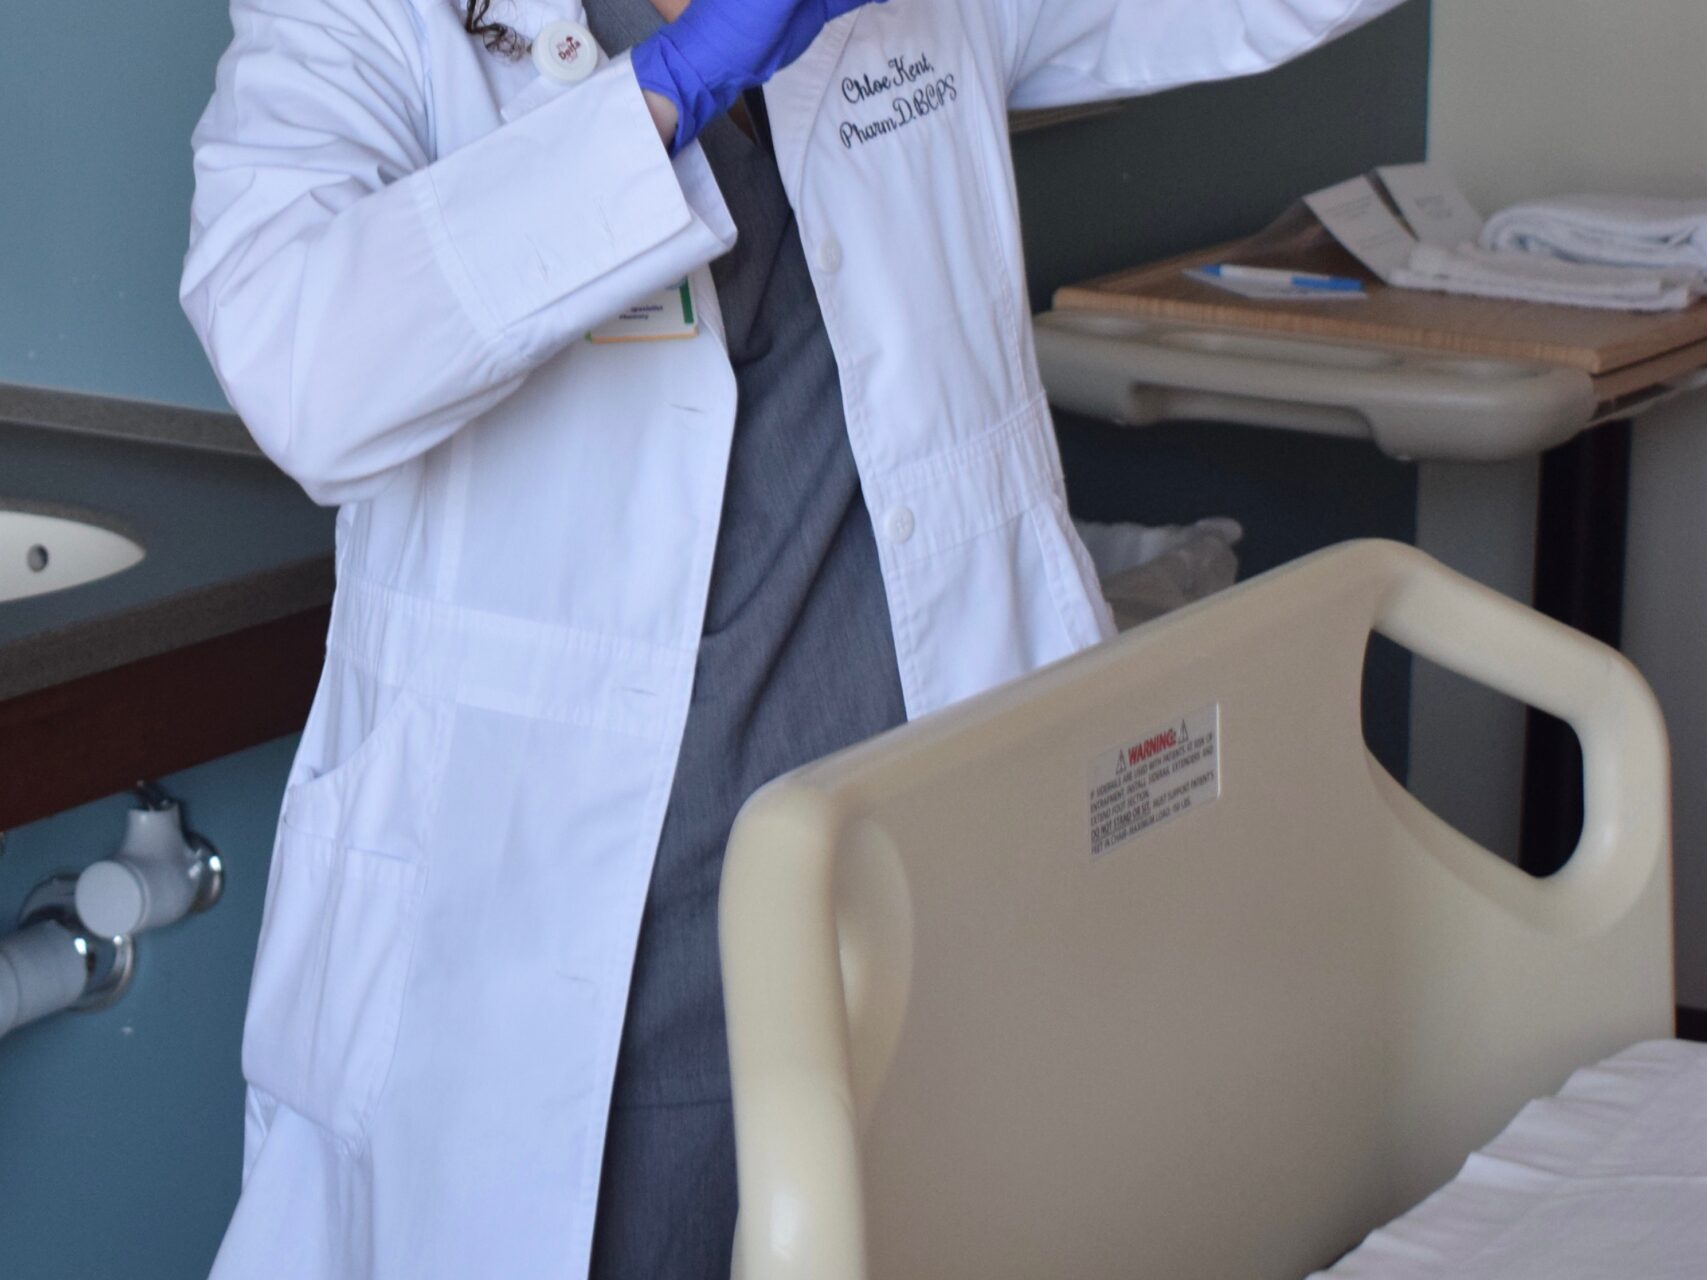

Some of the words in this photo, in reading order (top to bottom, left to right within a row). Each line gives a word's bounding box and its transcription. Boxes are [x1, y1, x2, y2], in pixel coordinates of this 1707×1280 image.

[841, 73, 891, 104] Chloe
[887, 51, 935, 87] Kent,
[1128, 728, 1176, 765] WARNING:
